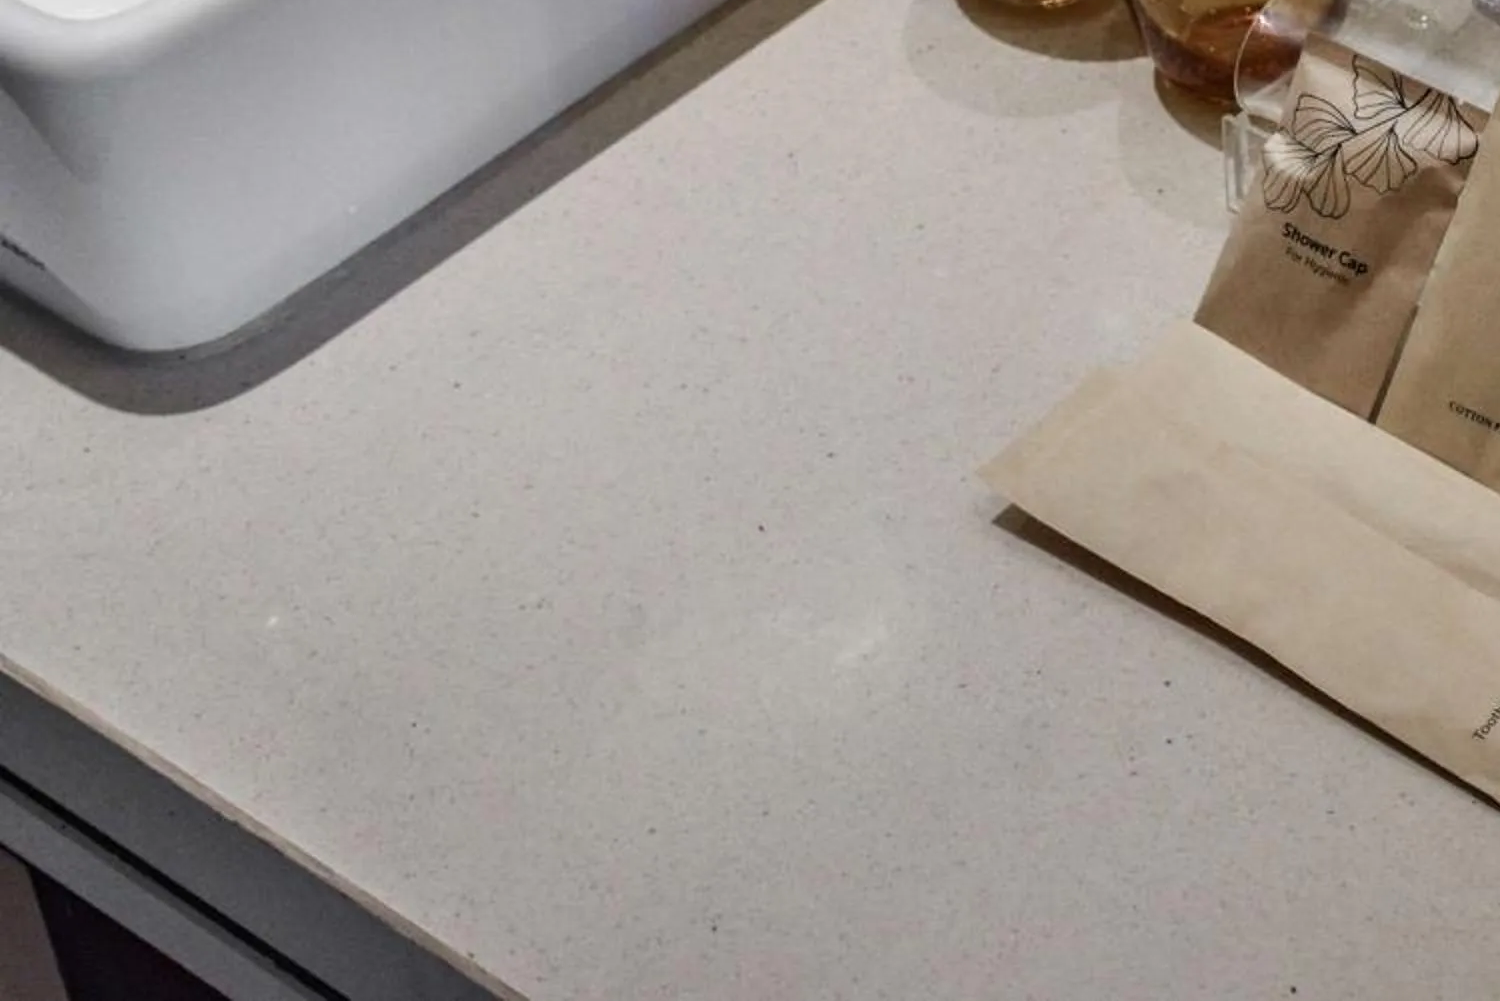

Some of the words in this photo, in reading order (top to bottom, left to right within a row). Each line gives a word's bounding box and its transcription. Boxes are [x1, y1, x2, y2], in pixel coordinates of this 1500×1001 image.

[1282, 222, 1337, 259] Shower
[1339, 250, 1368, 277] Cap
[1449, 401, 1492, 430] COTTON
